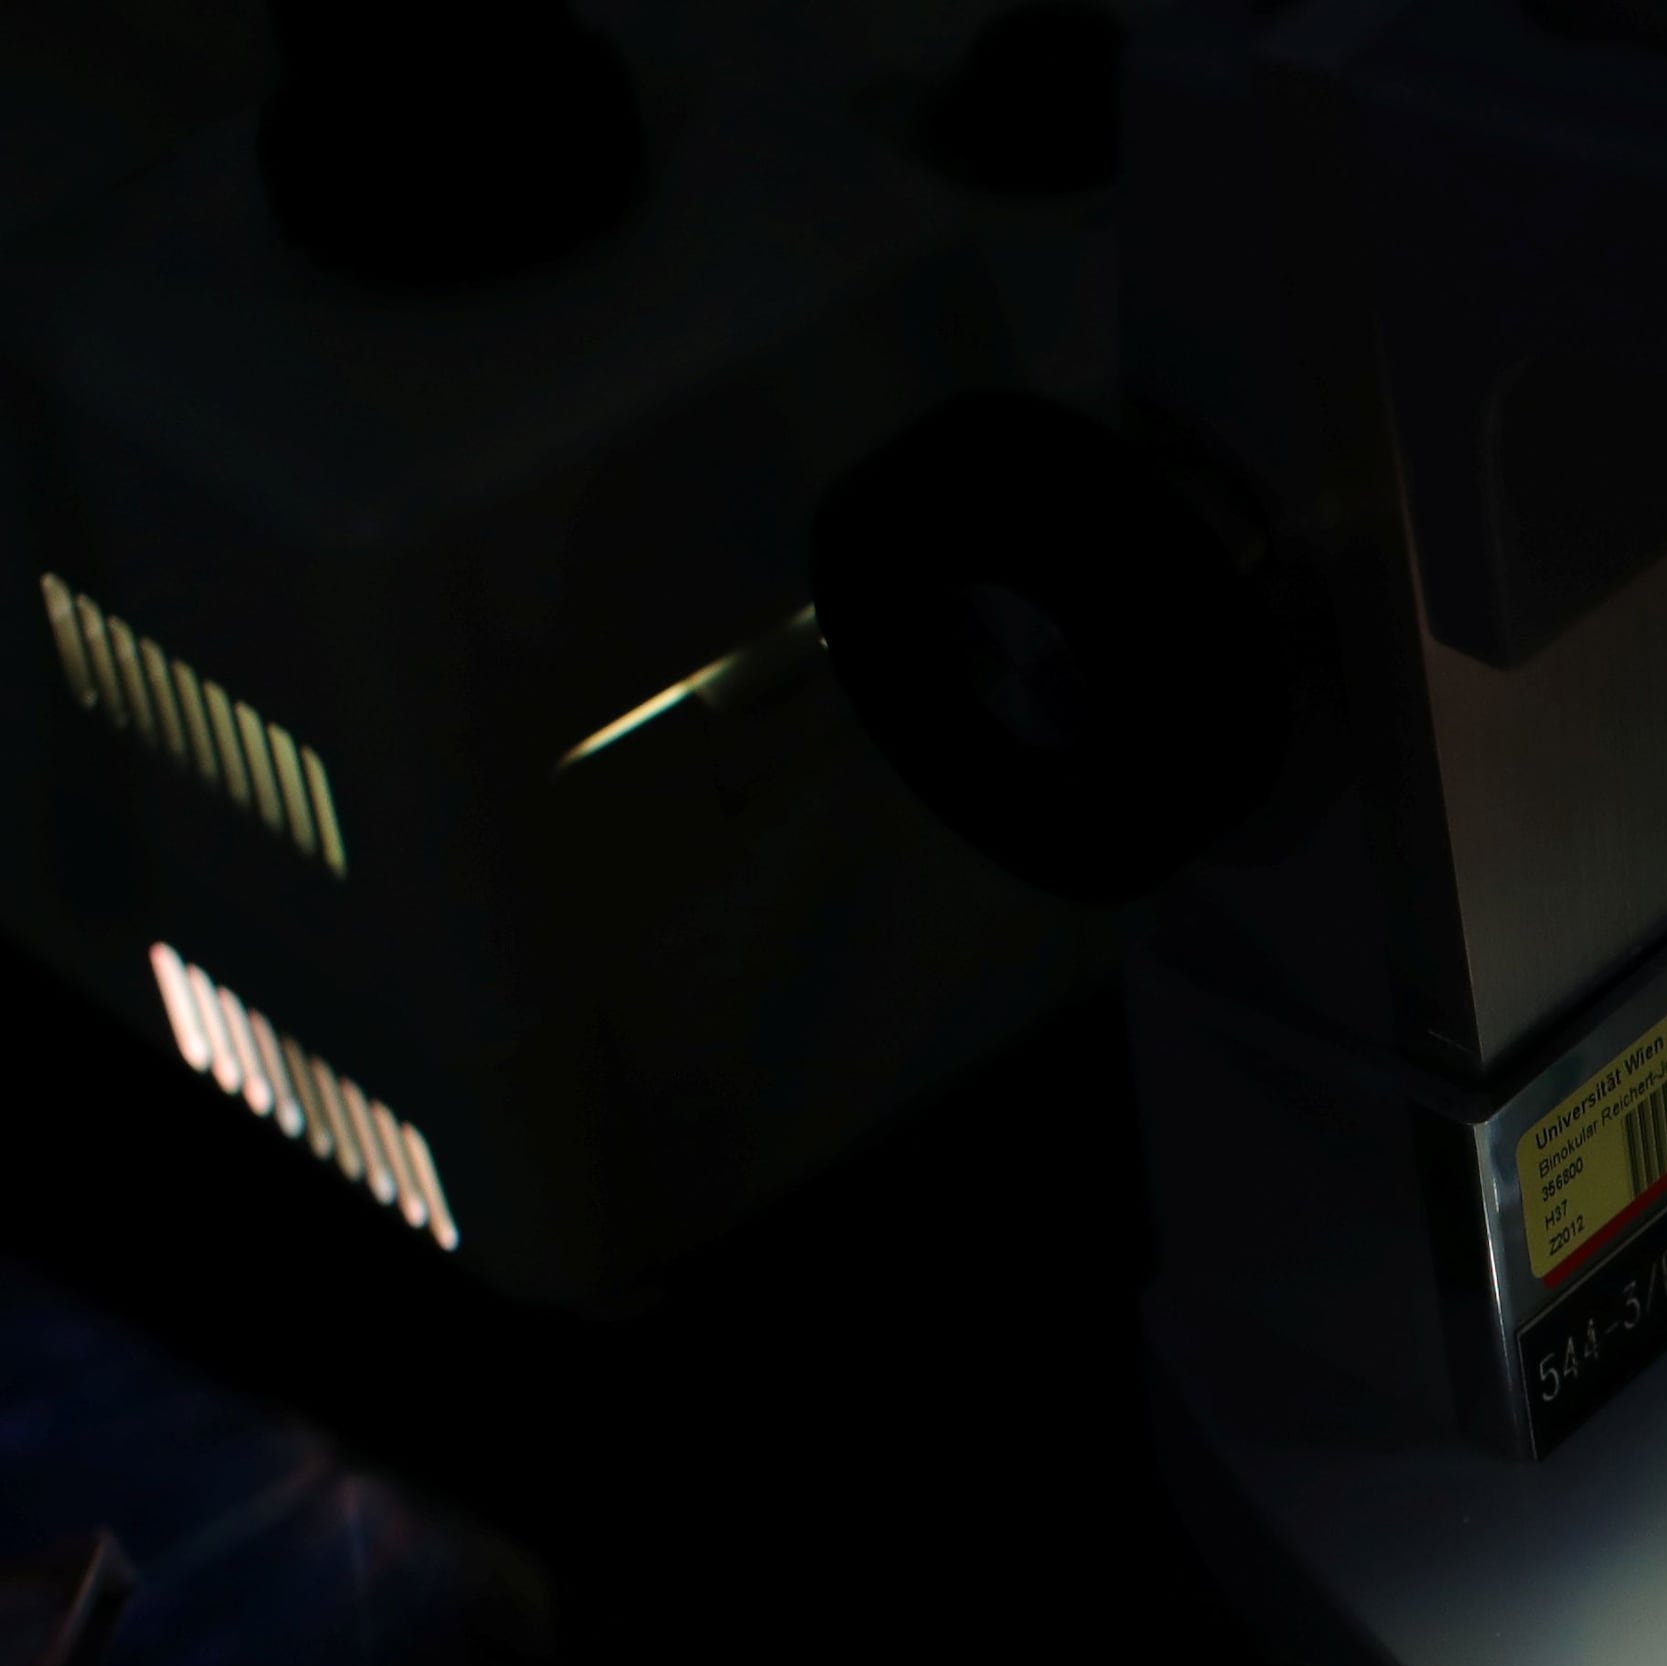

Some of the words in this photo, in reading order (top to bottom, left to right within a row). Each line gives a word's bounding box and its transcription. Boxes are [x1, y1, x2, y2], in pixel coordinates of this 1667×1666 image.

[1535, 1069, 1621, 1149] Universität
[1624, 1036, 1664, 1075] Wien
[1538, 1120, 1598, 1178] Binokular
[1541, 1156, 1584, 1202] 356800
[1544, 1199, 1568, 1231] H37
[1549, 1215, 1585, 1257] Z2012
